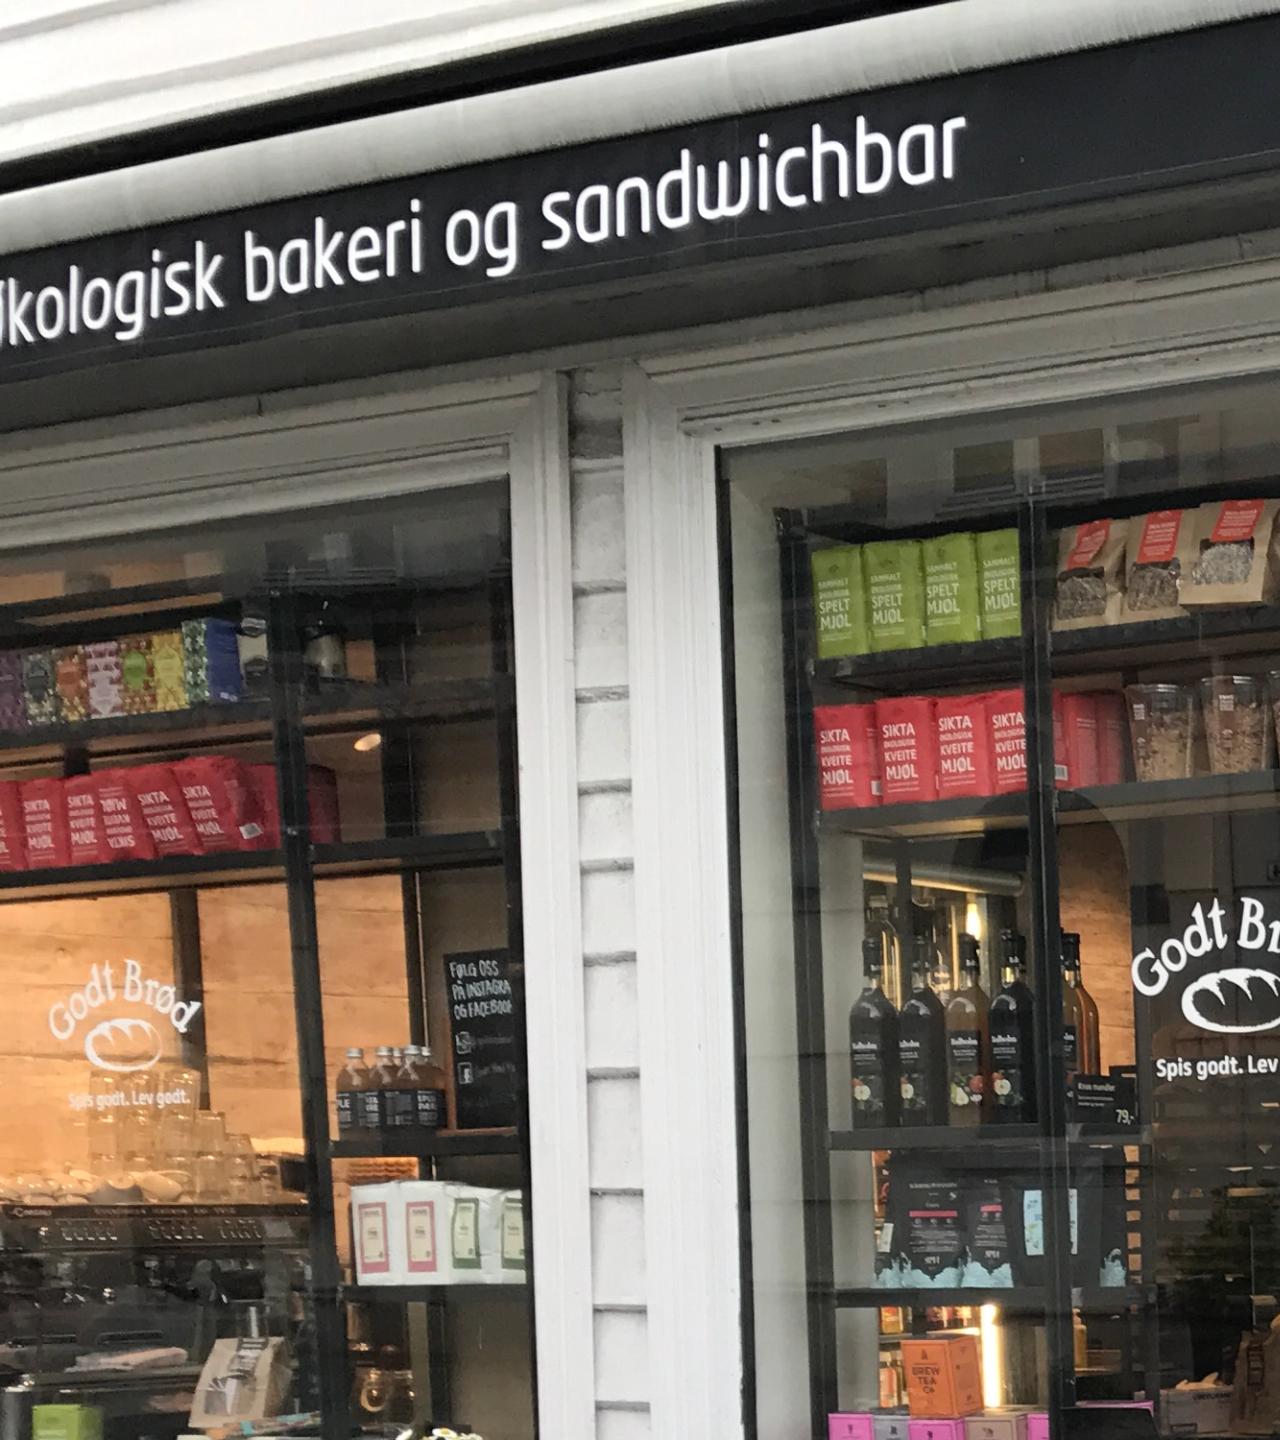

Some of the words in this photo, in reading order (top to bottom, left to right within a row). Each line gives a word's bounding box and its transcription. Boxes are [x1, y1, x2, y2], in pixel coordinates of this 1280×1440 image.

[0, 240, 225, 346] kologisk
[245, 199, 423, 303] bakeri
[446, 201, 517, 277] og
[543, 116, 967, 250] sandwichbar
[927, 583, 960, 598] SPELT
[984, 577, 1017, 594] SPELT
[819, 598, 850, 614] SPELT
[872, 593, 903, 609] SPELT
[938, 715, 972, 732] SIKTA
[992, 711, 1025, 729] SIKTA
[820, 728, 851, 744] SIKTA
[882, 722, 915, 738] SIKTA
[884, 749, 917, 762] KVEITE
[940, 741, 974, 756] KVEITE
[1131, 897, 1228, 997] Godt
[449, 961, 477, 979] FØLG
[478, 960, 500, 977] OSS
[466, 979, 512, 998] INSTAGRA
[49, 960, 116, 1040] Godt
[123, 959, 202, 1033] Brød
[454, 1003, 467, 1020] OG
[1156, 1057, 1192, 1081] Spis
[1196, 1055, 1244, 1080] godt.
[1248, 1055, 1279, 1073] Lev
[68, 1092, 95, 1110] Spis
[96, 1091, 130, 1111] godt.
[132, 1090, 153, 1105] Lev
[156, 1089, 191, 1109] godt.
[912, 1366, 939, 1376] BREW
[918, 1376, 936, 1385] TEA
